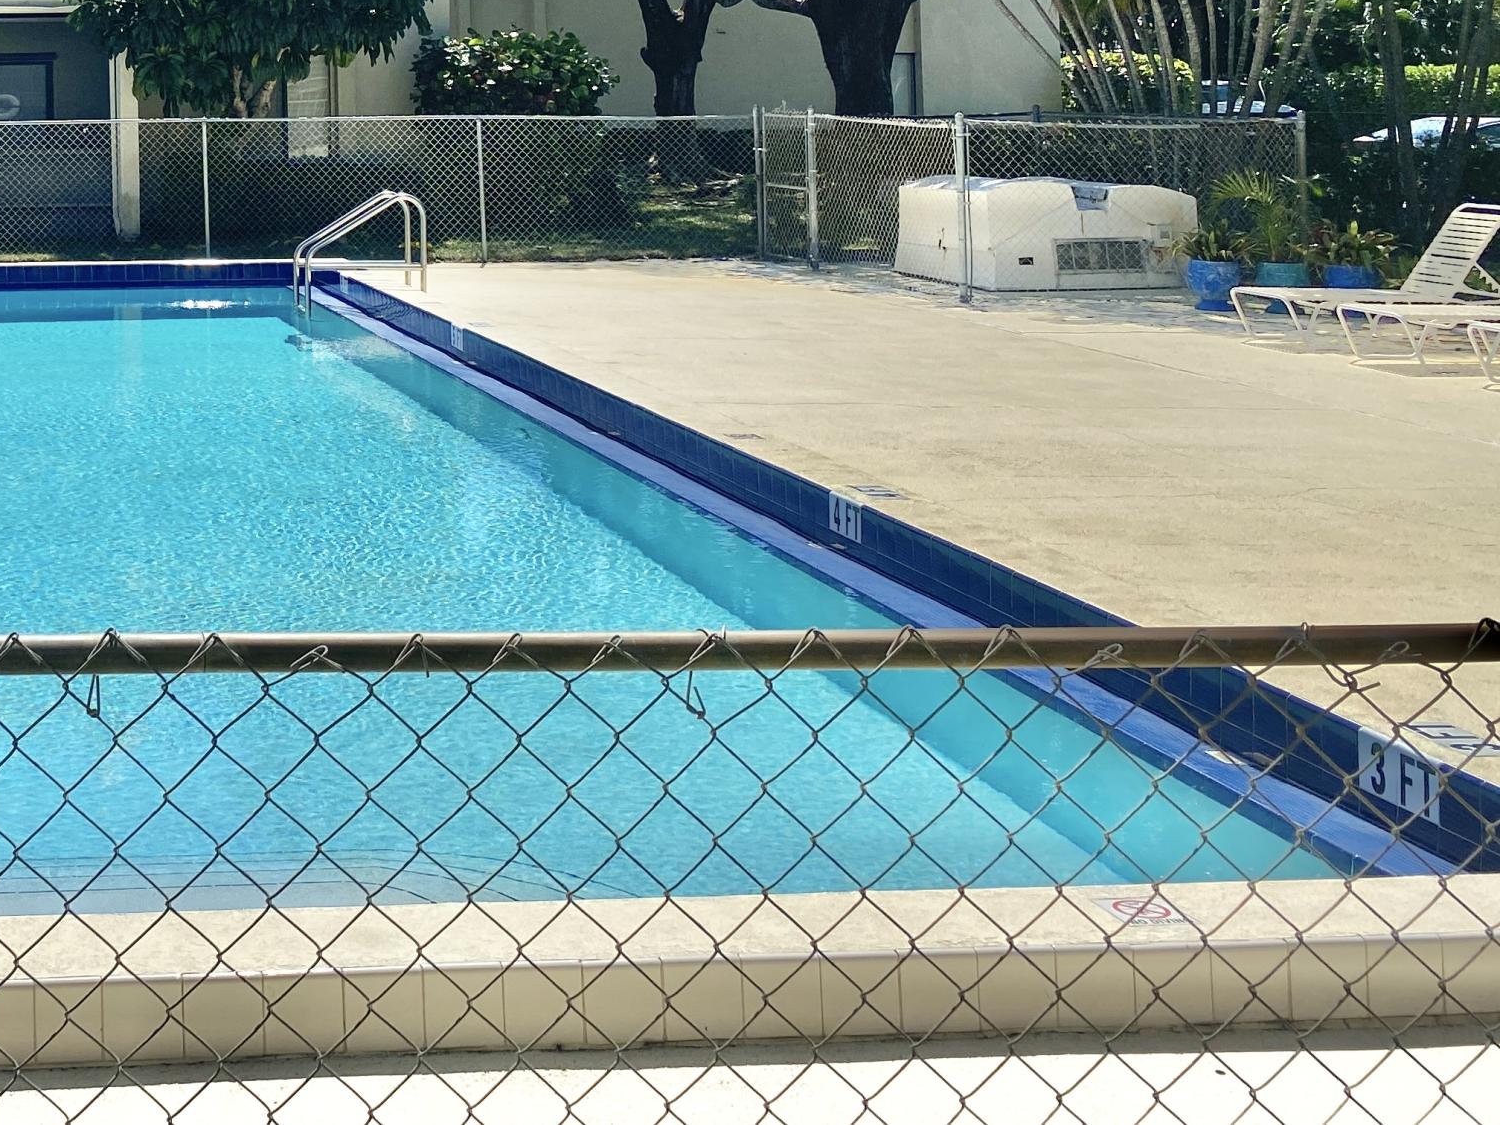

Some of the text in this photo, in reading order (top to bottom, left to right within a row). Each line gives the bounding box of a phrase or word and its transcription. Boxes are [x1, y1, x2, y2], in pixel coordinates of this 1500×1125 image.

[833, 497, 860, 541] 4 FT
[1370, 741, 1437, 818] 3 FT
